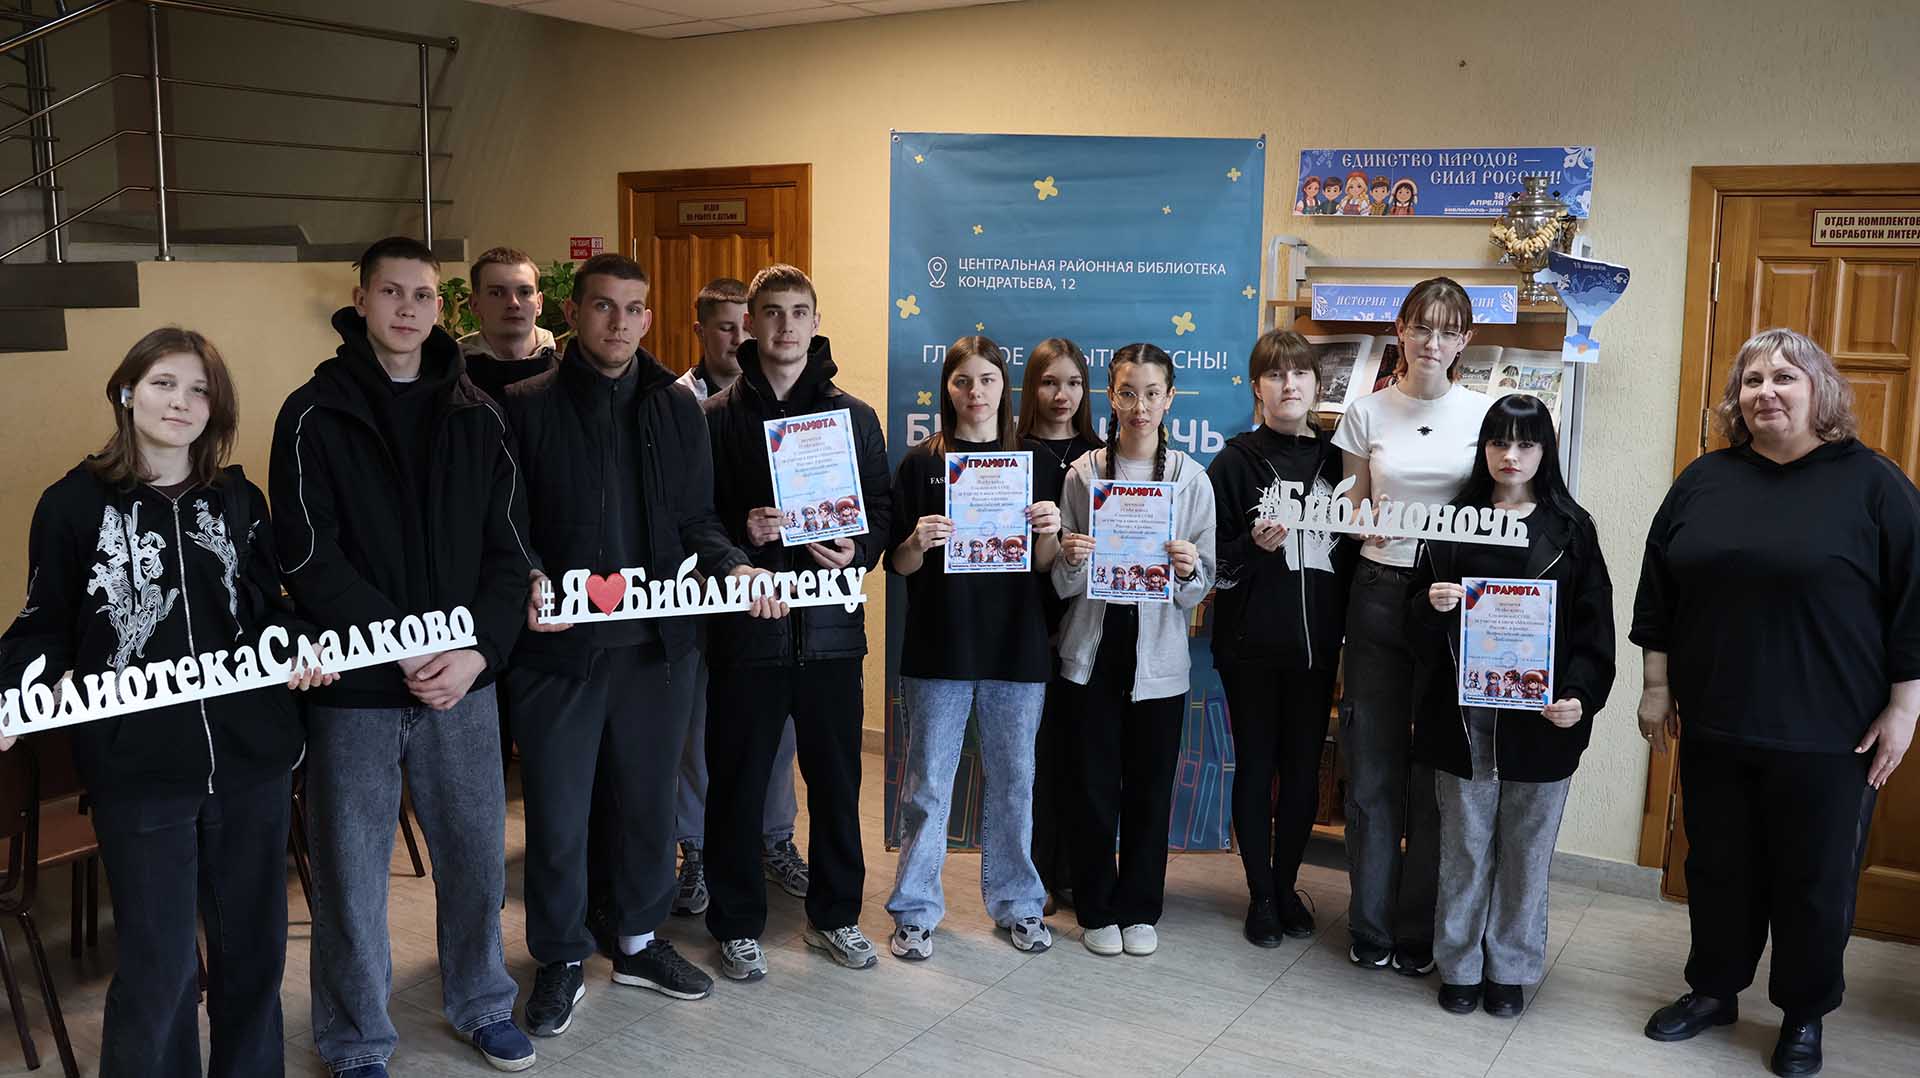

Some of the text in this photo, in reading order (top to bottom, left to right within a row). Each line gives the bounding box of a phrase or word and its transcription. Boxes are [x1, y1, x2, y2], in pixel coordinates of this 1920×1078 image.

[1342, 153, 1433, 168] ЕДИНСТВО
[1439, 152, 1518, 169] НАРОДОВ
[1430, 170, 1476, 185] СИЛА
[1824, 217, 1855, 227] ОТДЕЛ
[1820, 230, 1827, 239] И
[1829, 230, 1885, 239] ОБРАБОТКИ
[958, 258, 1227, 275] ЦЕНТРАЛЬНАЯ РАЙОННАЯ БИБЛИОТЕКА
[958, 276, 1076, 291] КОНДРАТЬЕВА, 12
[1336, 296, 1387, 306] ИСТОРИЯ
[923, 345, 1228, 370] ГЛОЕ СНЫ!
[787, 418, 837, 434] ГРАМОТА
[968, 458, 1018, 468] ГРАМОТА
[930, 477, 945, 485] FAS
[1113, 486, 1163, 497] ГРАМОТА
[1486, 585, 1541, 597] ГРАМОТА
